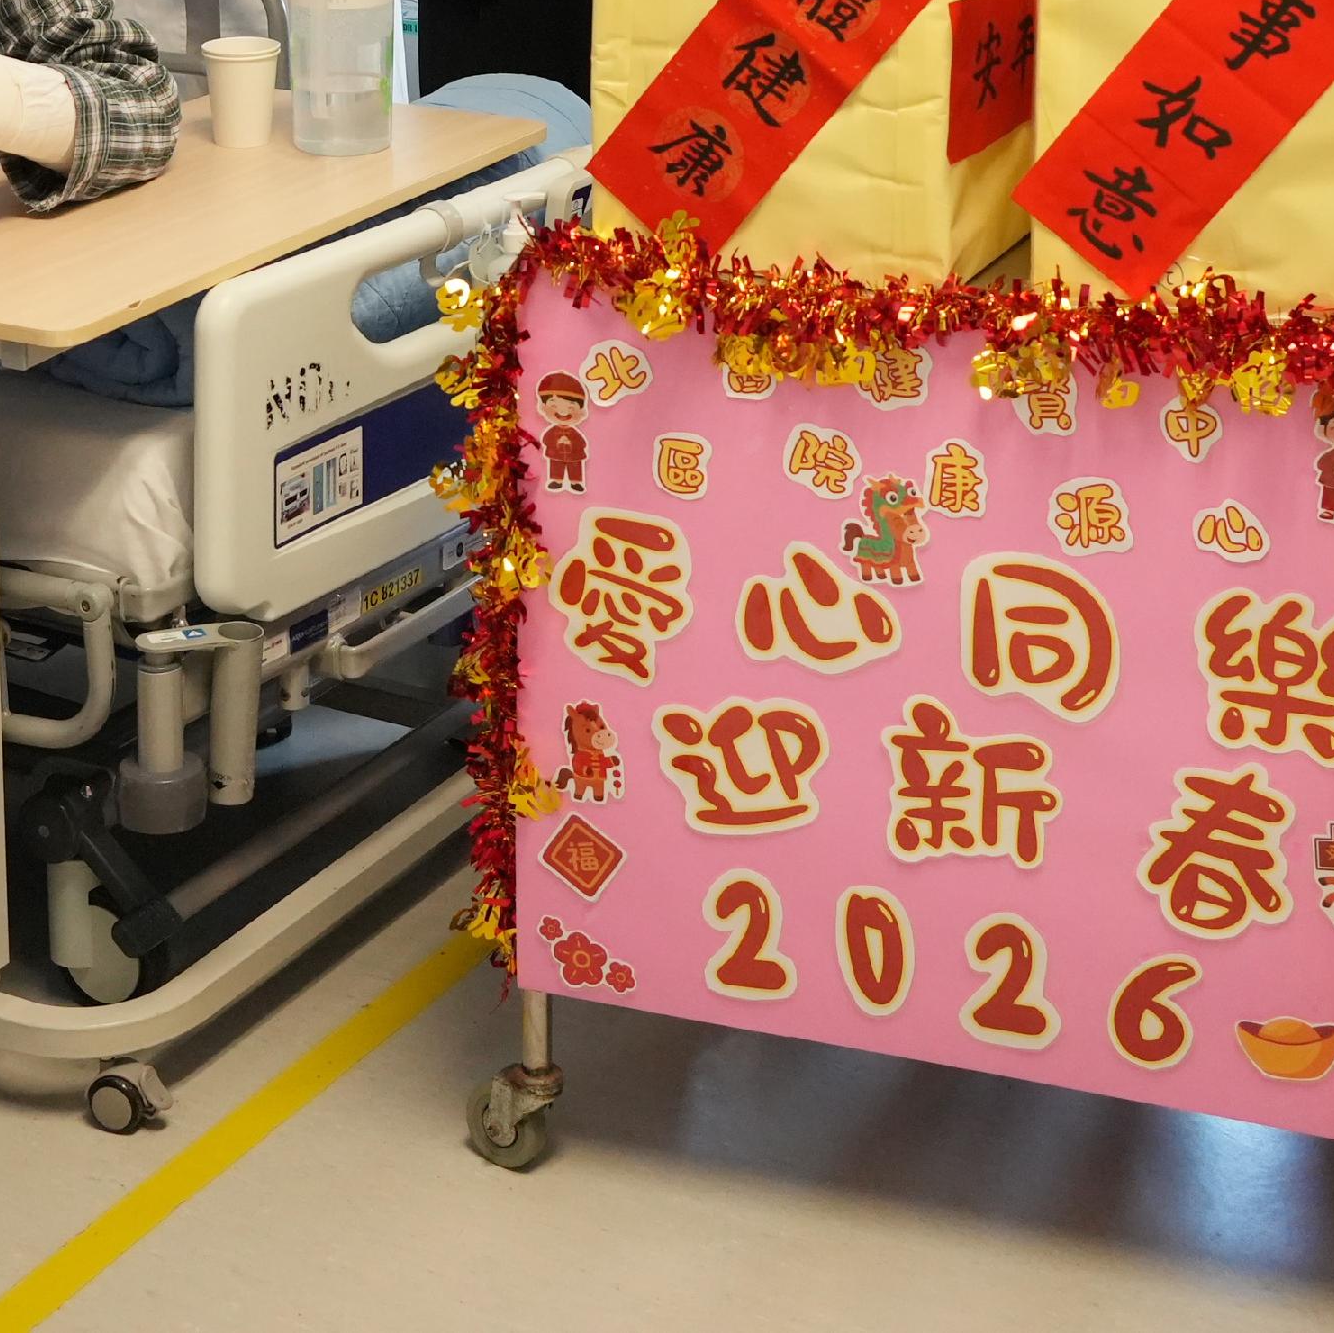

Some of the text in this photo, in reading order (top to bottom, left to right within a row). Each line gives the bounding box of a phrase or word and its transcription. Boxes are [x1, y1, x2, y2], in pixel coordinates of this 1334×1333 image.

[381, 568, 420, 600] 821337
[568, 842, 600, 872] 福
[661, 701, 1287, 923] 迎新春
[707, 880, 1202, 1063] 2026
